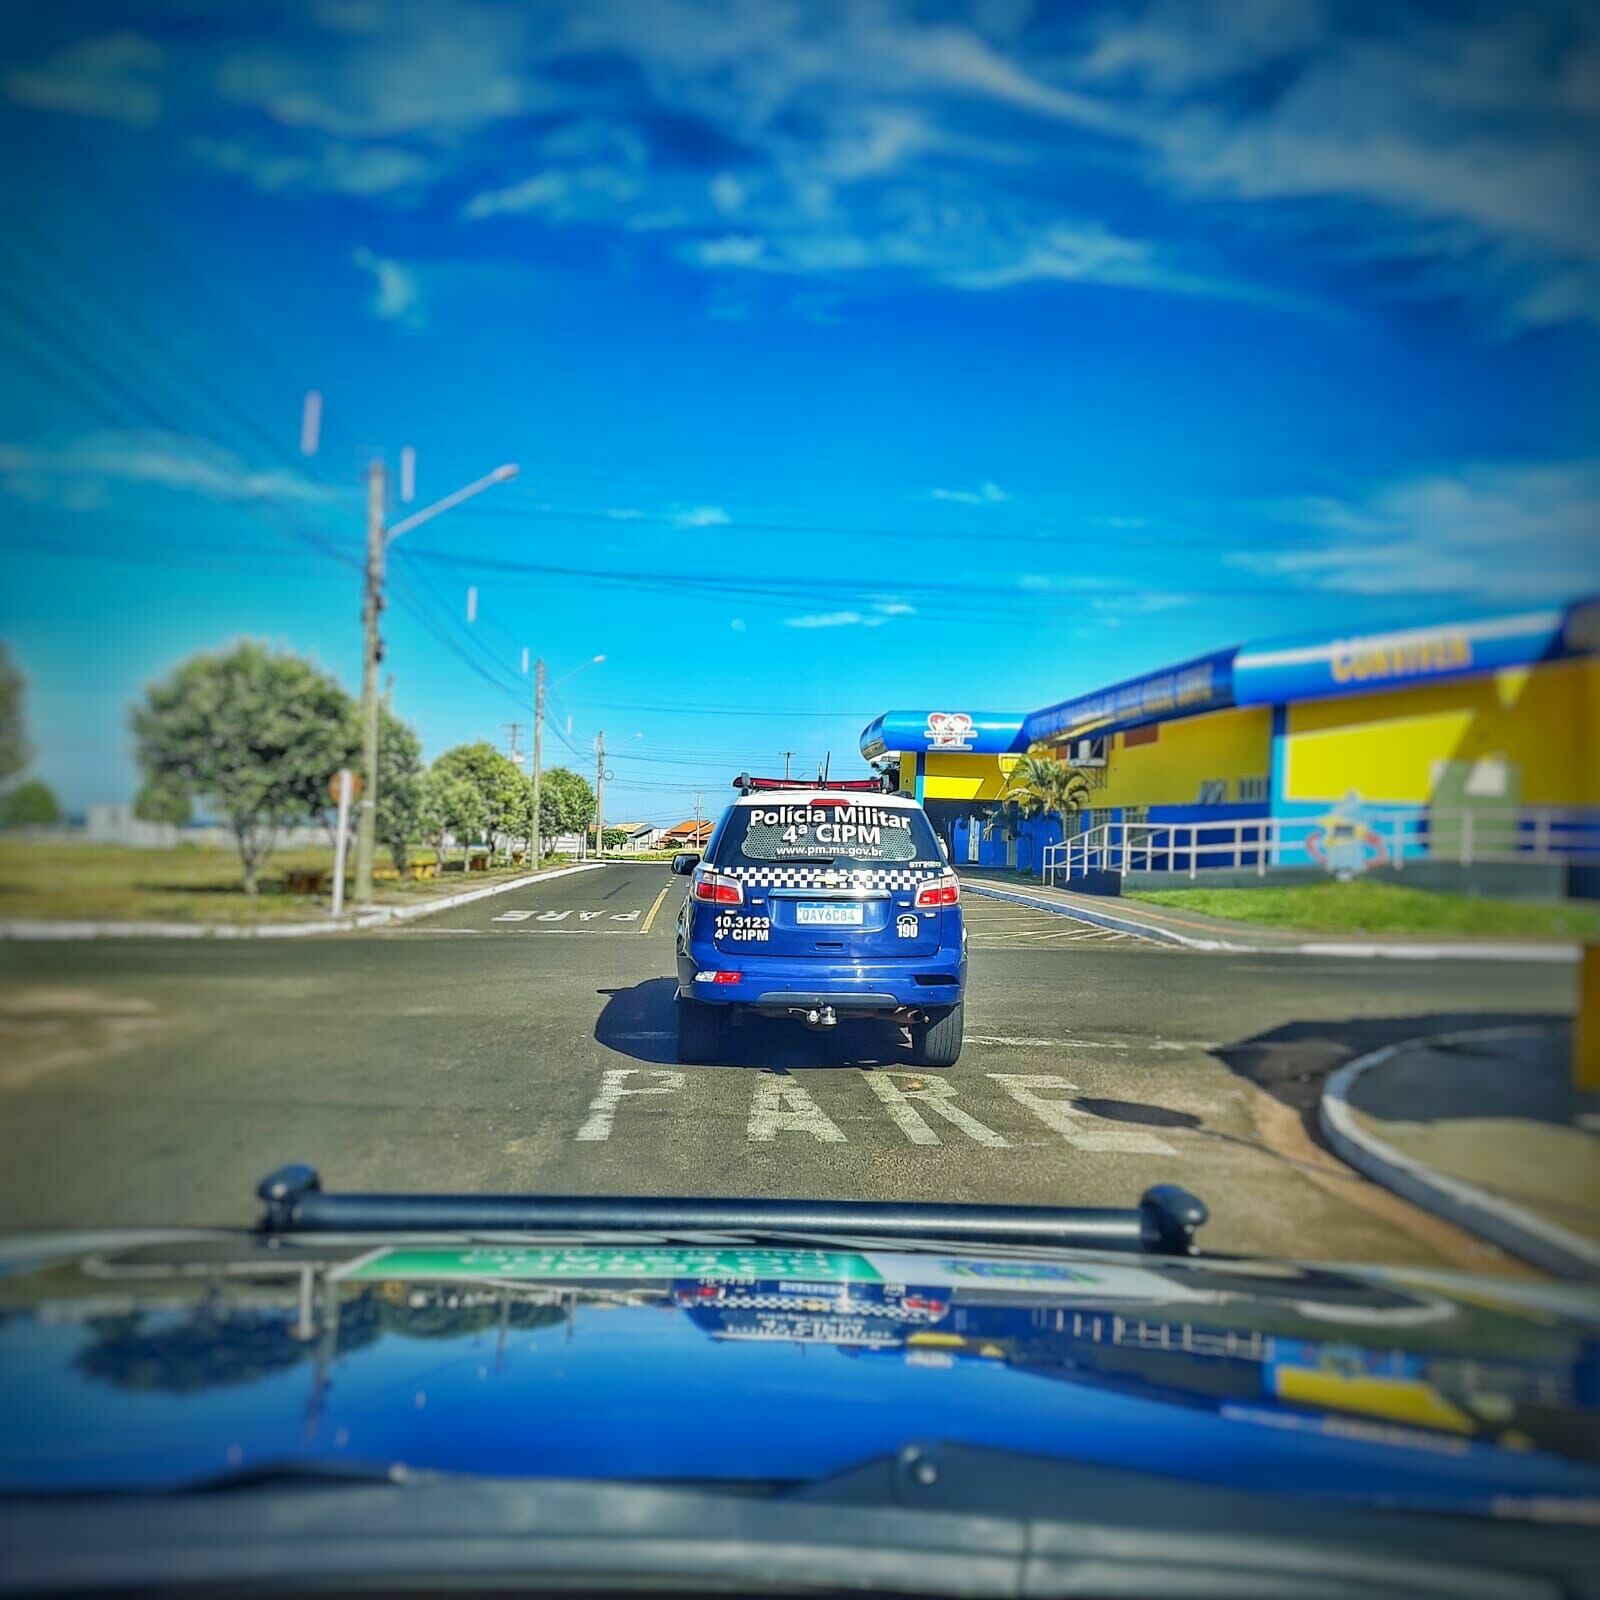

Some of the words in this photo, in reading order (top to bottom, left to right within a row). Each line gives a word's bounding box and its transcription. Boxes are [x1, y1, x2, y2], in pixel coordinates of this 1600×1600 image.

[750, 804, 826, 827] Polícia
[834, 805, 911, 829] Militar
[782, 824, 808, 843] 4ª
[815, 823, 881, 845] CIPM
[776, 844, 884, 858] www.pm.ms.gov.br
[491, 909, 642, 922] PARE
[715, 915, 770, 929] 10.3123
[732, 928, 769, 941] CIPM
[896, 923, 919, 938] 190
[575, 1068, 1178, 1156] PARE
